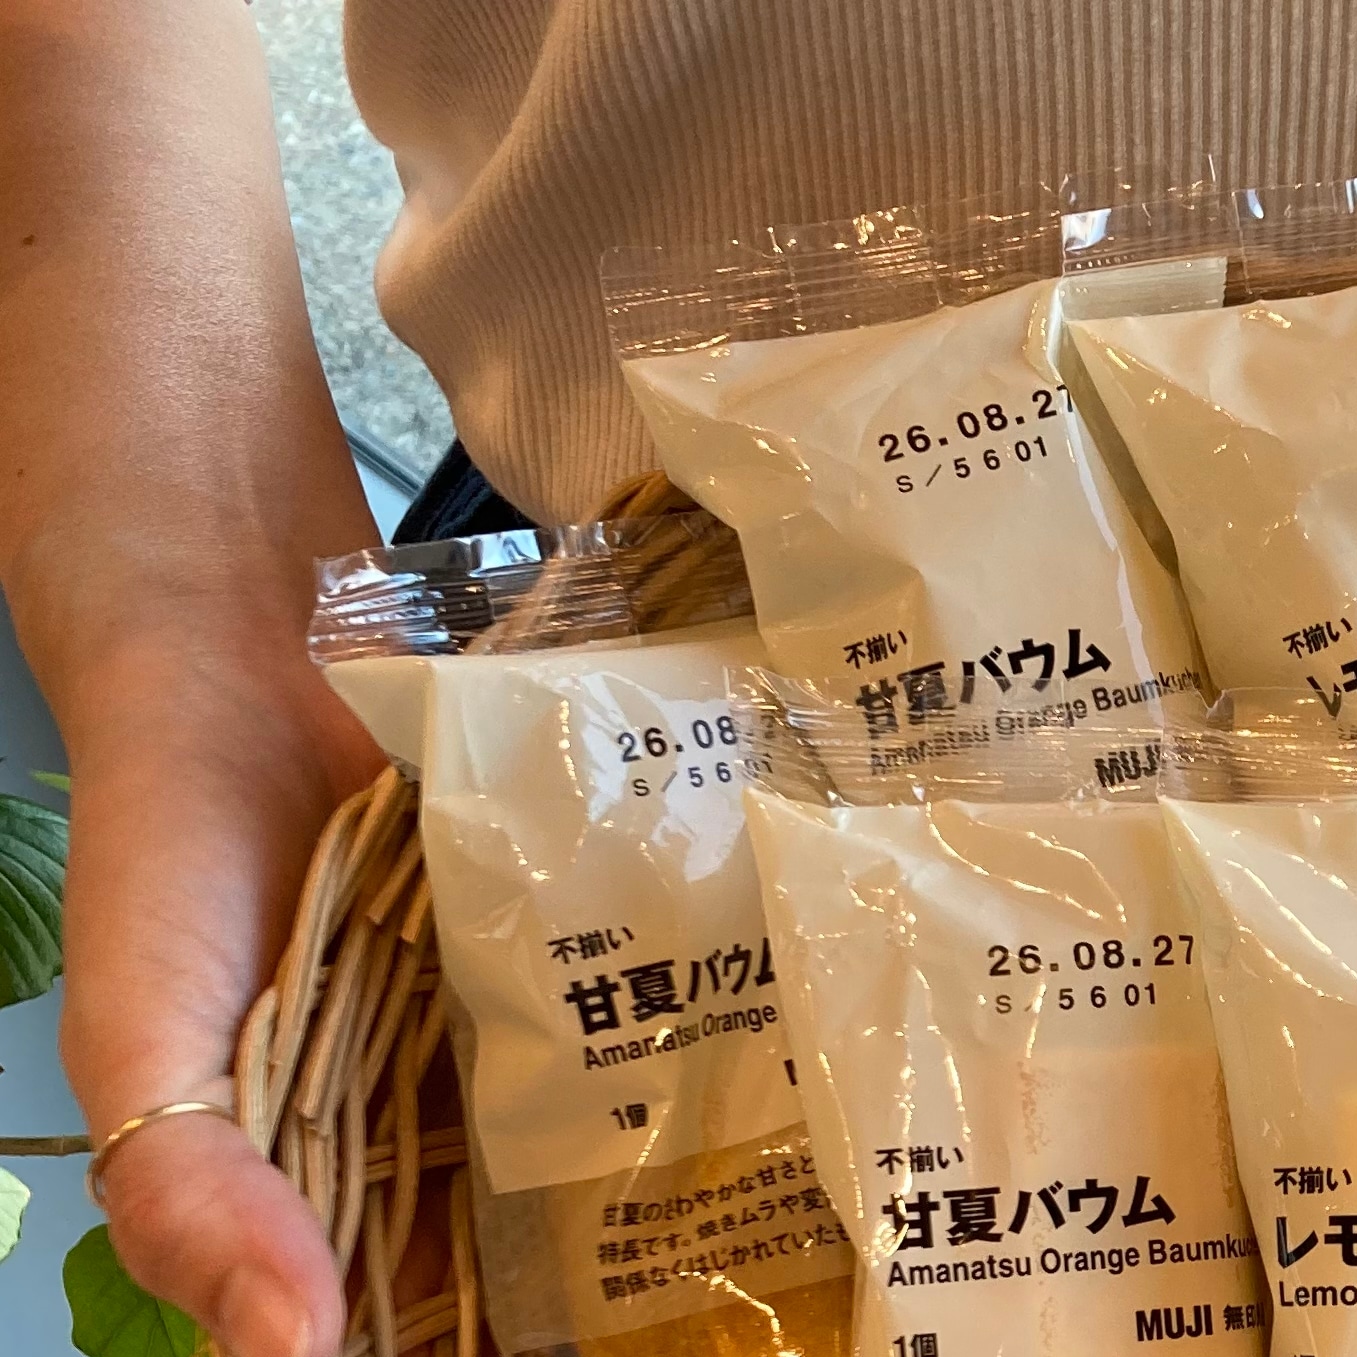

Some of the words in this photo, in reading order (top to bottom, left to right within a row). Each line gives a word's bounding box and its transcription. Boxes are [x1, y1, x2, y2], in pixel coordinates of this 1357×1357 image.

[878, 384, 1073, 463] 26.08.27
[843, 630, 908, 670] 不揃い
[1282, 617, 1353, 660] 不揃い
[547, 926, 635, 965] 不揃い
[987, 935, 1194, 977] 26.08.27
[702, 1005, 778, 1037] Orange
[875, 1146, 964, 1175] 不揃い
[1273, 1166, 1352, 1195] 不揃い
[882, 1175, 1176, 1251] 甘夏バウム
[888, 1255, 1032, 1288] Amanatsu
[1040, 1243, 1141, 1276] Orange
[1136, 1304, 1213, 1342] MUJI
